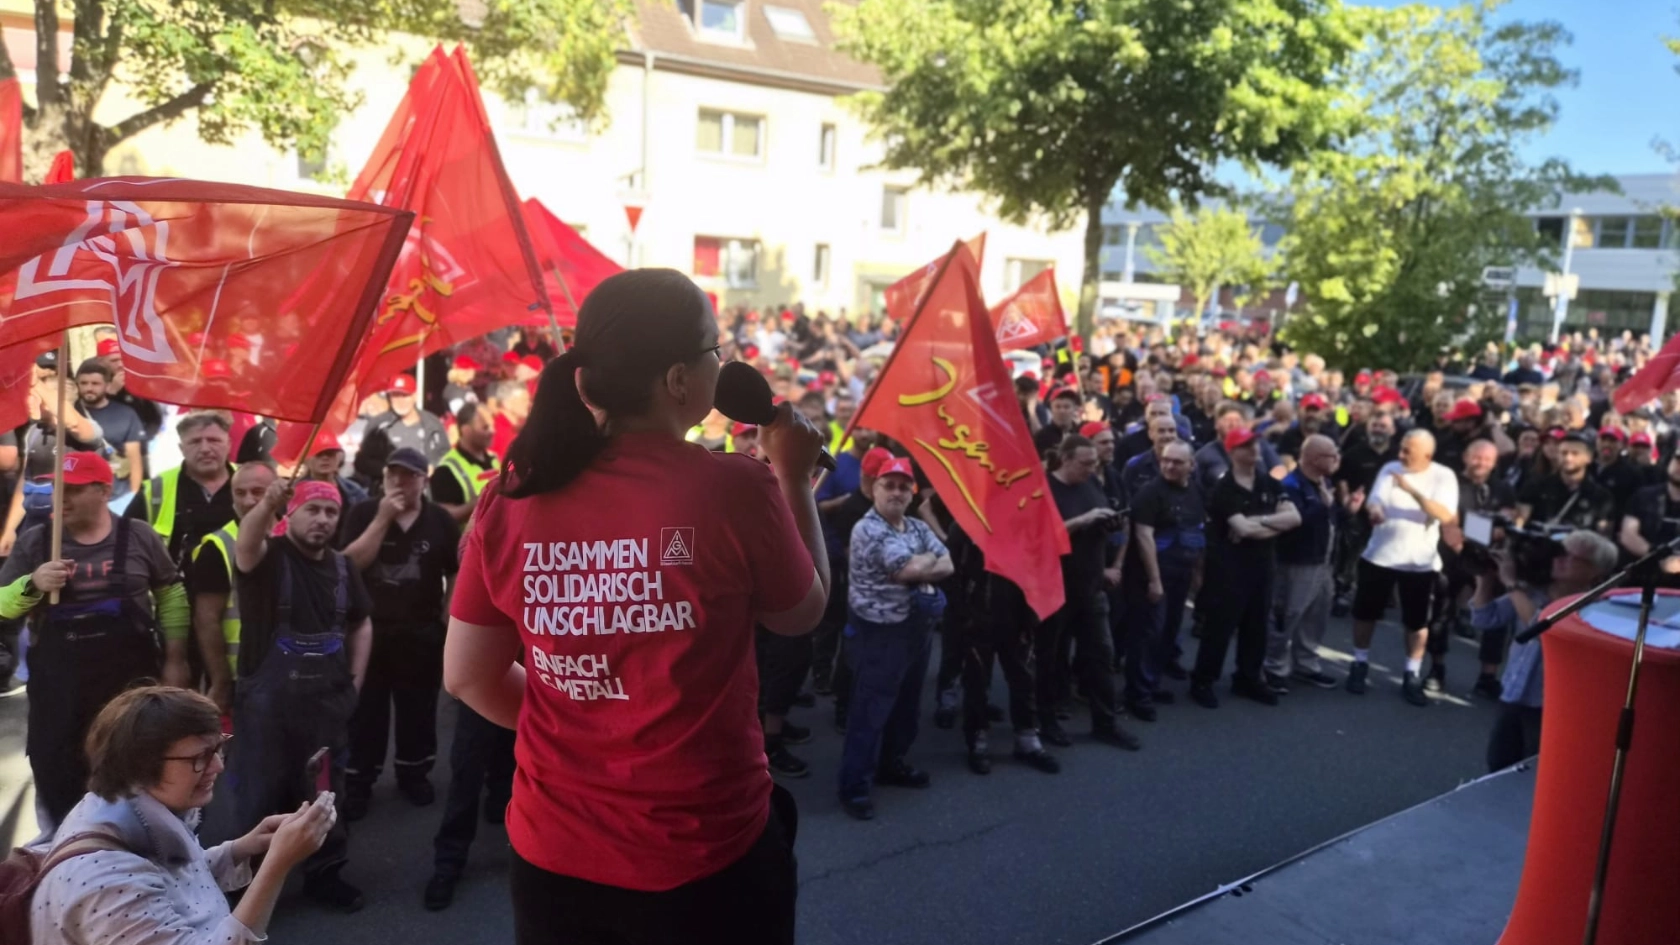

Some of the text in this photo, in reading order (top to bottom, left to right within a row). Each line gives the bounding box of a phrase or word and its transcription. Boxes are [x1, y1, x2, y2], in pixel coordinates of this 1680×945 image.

[523, 538, 648, 572] ZUSAMMEN
[523, 571, 663, 604] SOLIDARISCH
[523, 601, 696, 636] UNSCHLAGBAR
[532, 645, 610, 678] EINFACH
[554, 677, 630, 701] METALL
